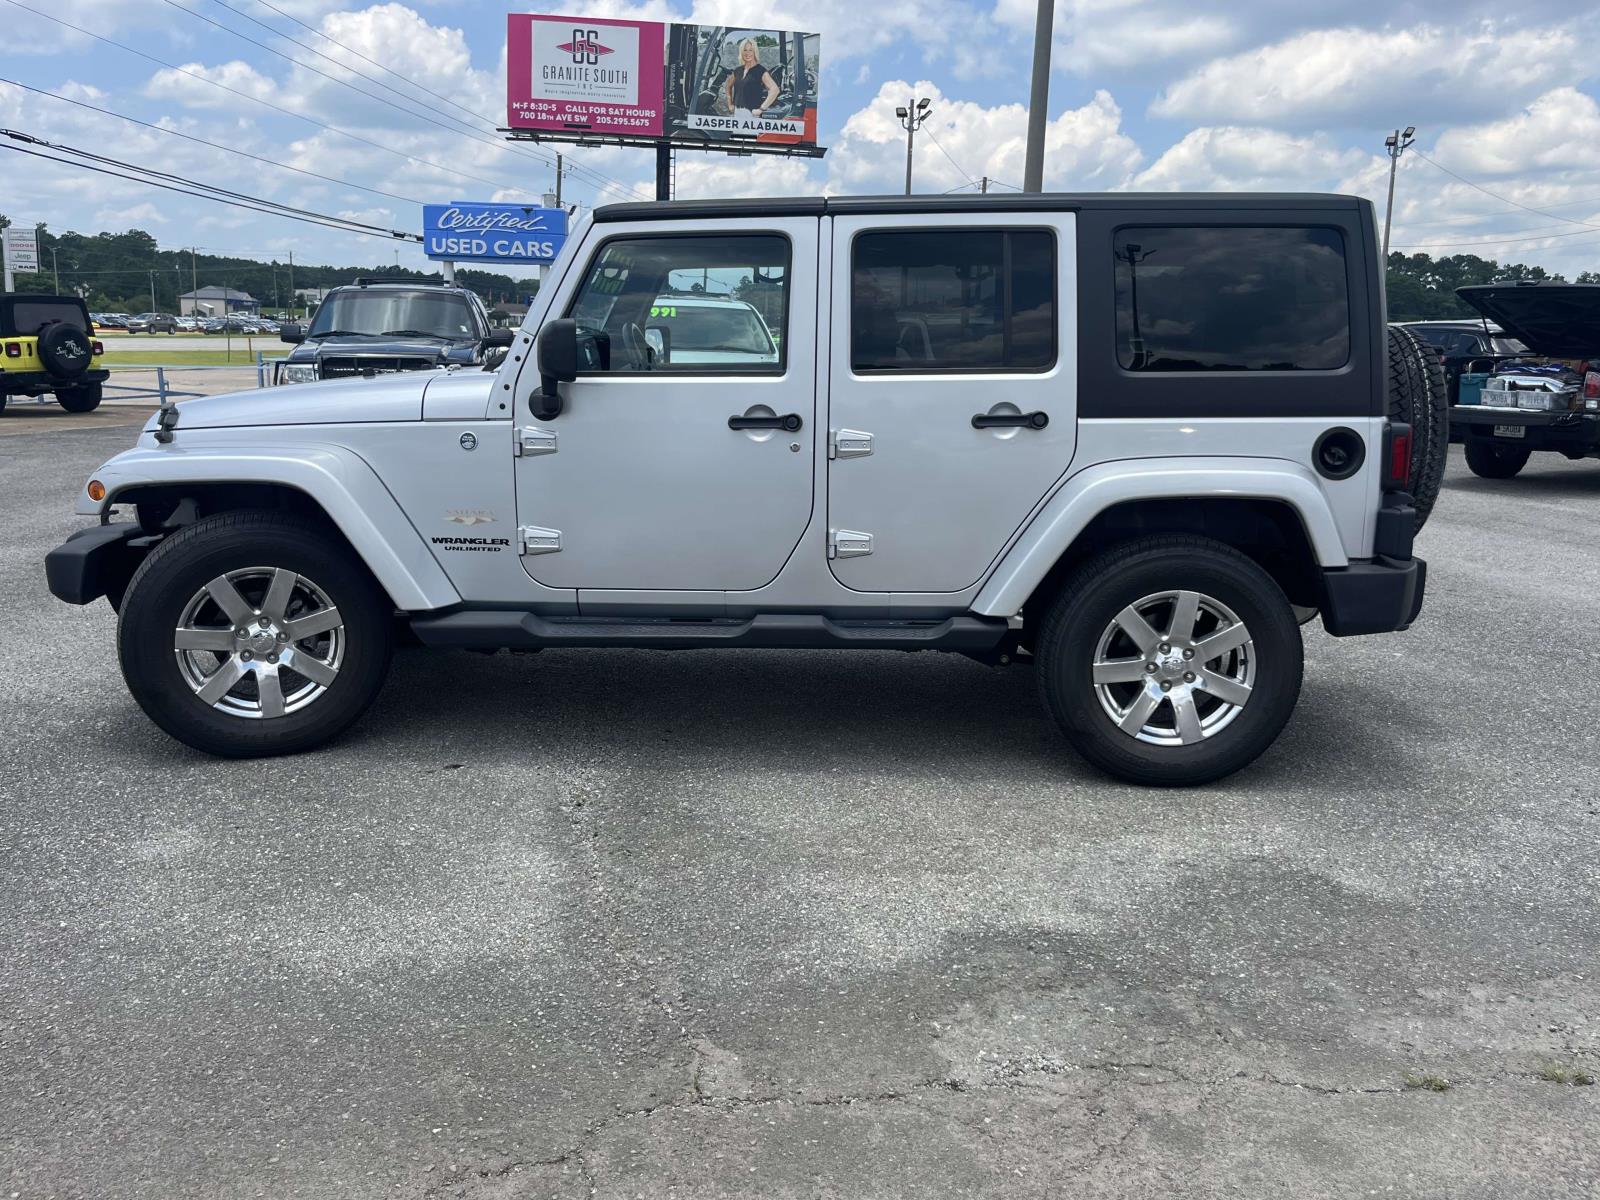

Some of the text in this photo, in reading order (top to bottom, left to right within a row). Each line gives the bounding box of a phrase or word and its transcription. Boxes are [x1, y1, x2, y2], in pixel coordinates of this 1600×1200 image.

[542, 65, 628, 85] GRANITE SOUTH
[530, 103, 557, 112] 8:30-5
[565, 104, 588, 113] CALL
[589, 106, 607, 115] FOR
[608, 107, 625, 116] SAT
[626, 109, 656, 118] HOURS
[519, 111, 536, 120] 700
[556, 113, 573, 122] AVE
[574, 114, 588, 123] SW
[596, 116, 650, 127] 205.295.5675
[695, 117, 797, 133] JASPER ALABAMA
[437, 207, 548, 236] Certified
[431, 237, 554, 257] USED CARS
[431, 537, 511, 546] WRANGLER
